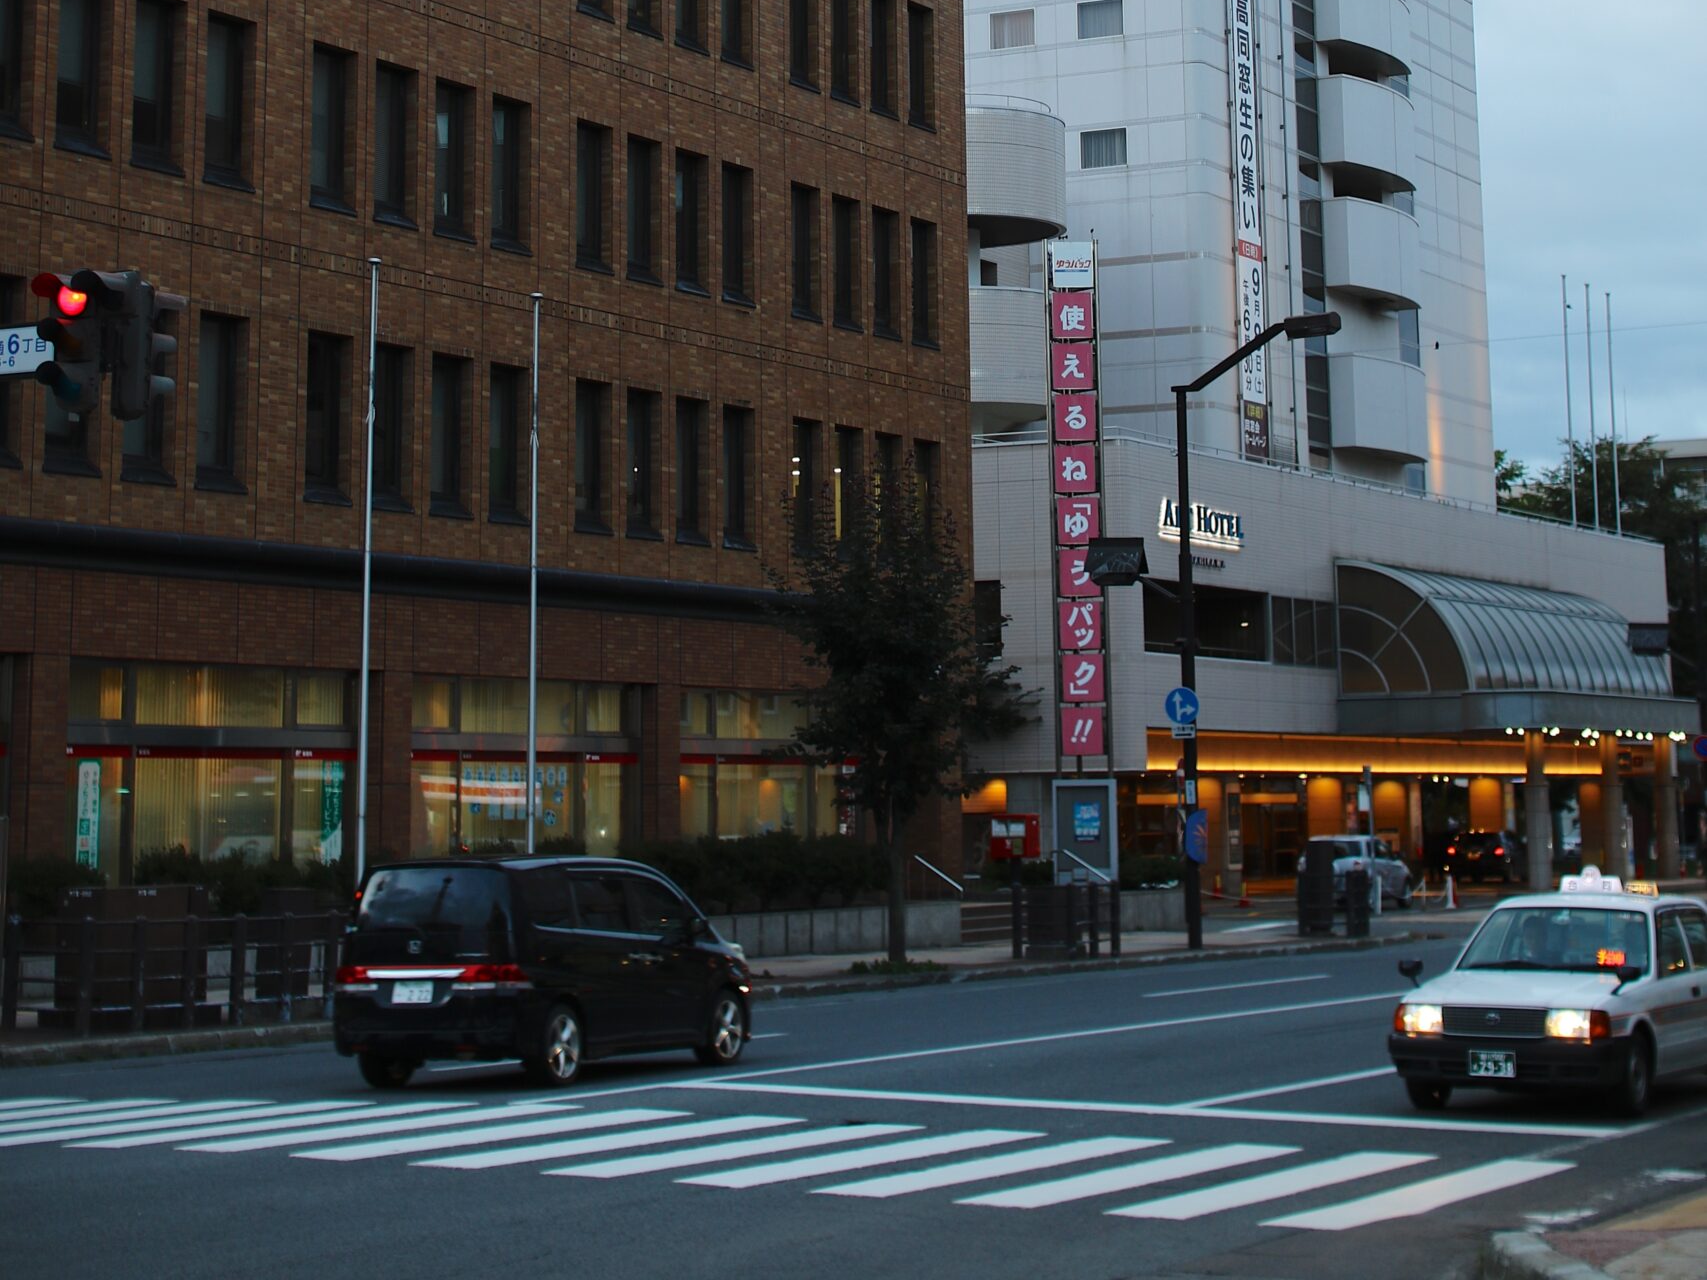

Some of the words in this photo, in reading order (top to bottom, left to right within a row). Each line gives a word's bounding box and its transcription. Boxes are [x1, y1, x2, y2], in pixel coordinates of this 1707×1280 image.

[1056, 258, 1091, 269] ゆうパック
[0, 356, 15, 367] -6
[1196, 505, 1244, 539] HOTEL
